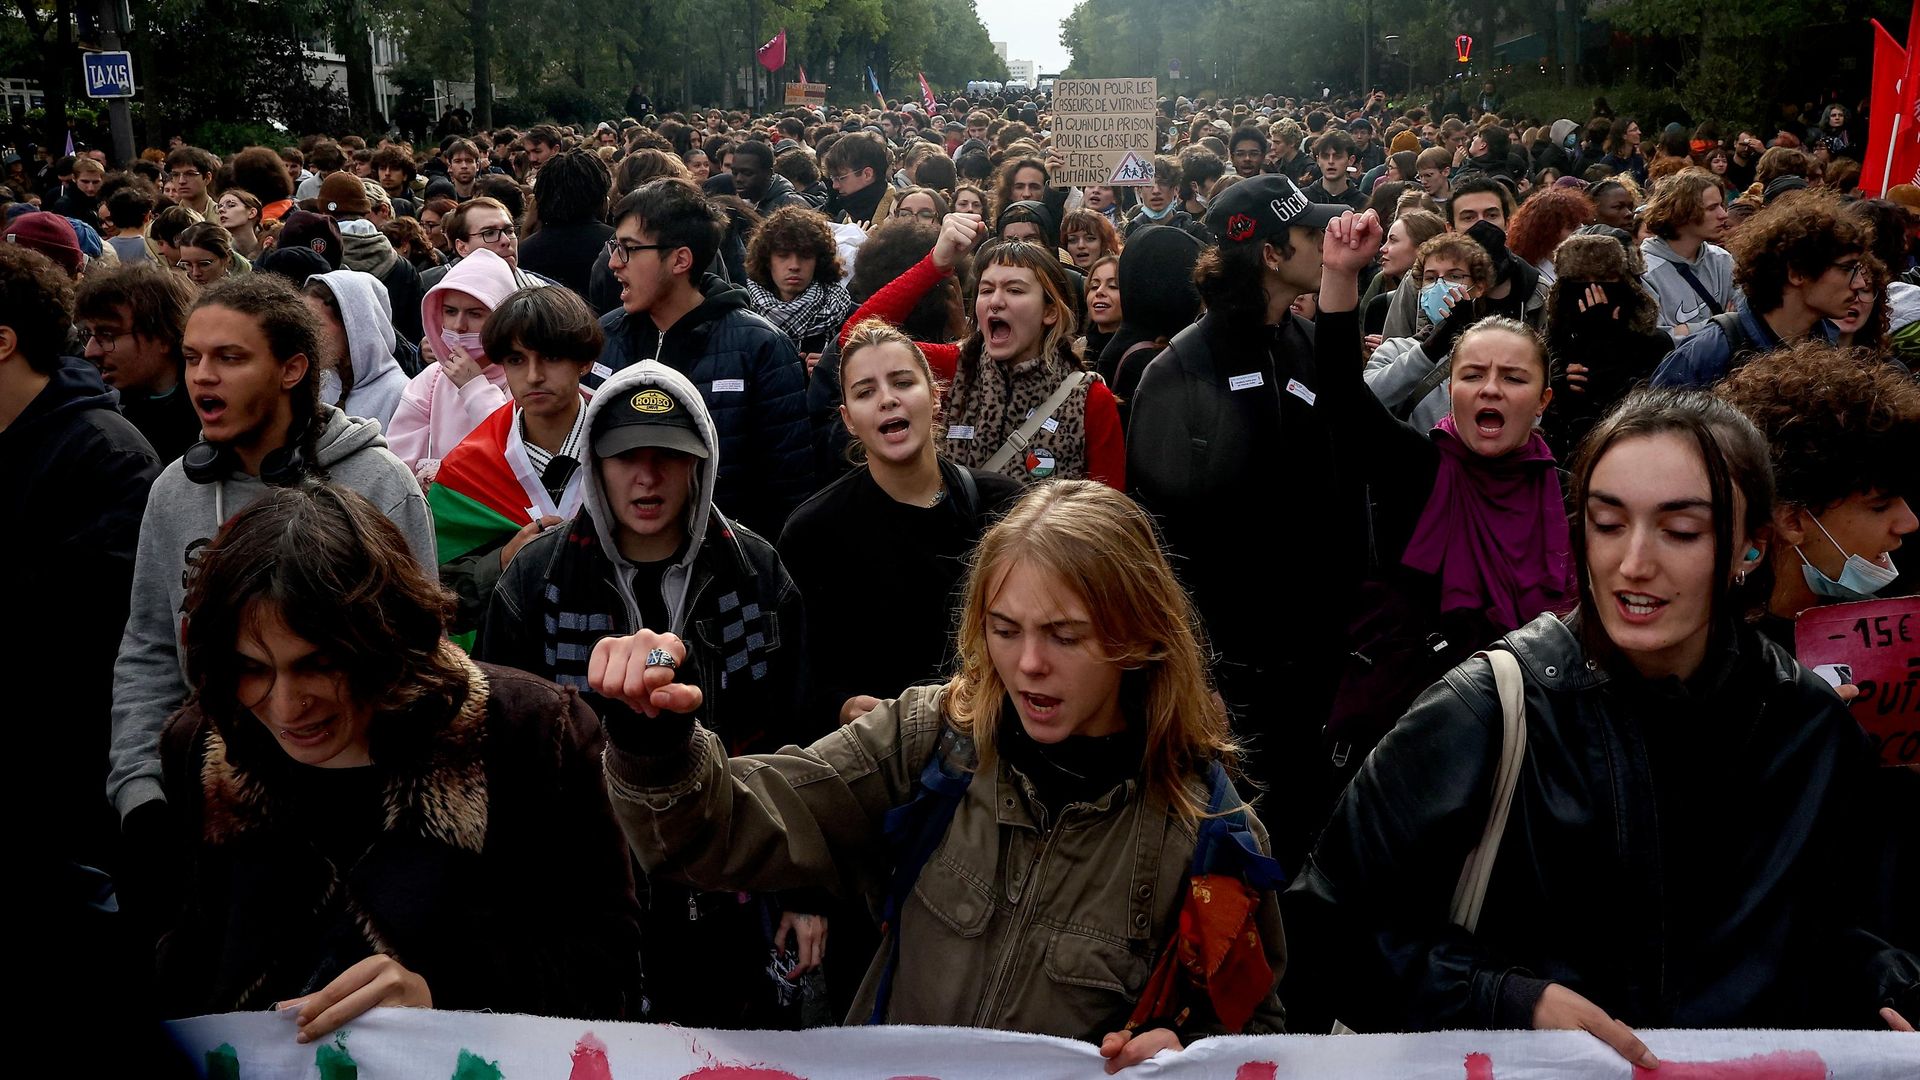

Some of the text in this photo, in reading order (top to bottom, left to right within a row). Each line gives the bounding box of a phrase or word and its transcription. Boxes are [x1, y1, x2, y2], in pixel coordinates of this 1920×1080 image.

[89, 65, 129, 86] TAXIS
[1059, 81, 1153, 96] PRISON POUR LES
[1053, 98, 1155, 112] CASSEURS DE VITRINES
[1055, 114, 1154, 132] À QUAND LA PRISON
[1056, 133, 1149, 149] POUR LES CASSEURS
[1062, 150, 1104, 169] 'ÊTRES
[1054, 168, 1111, 184] HUMAINS?
[635, 397, 670, 407] RODEO
[1851, 680, 1920, 716] PUT
